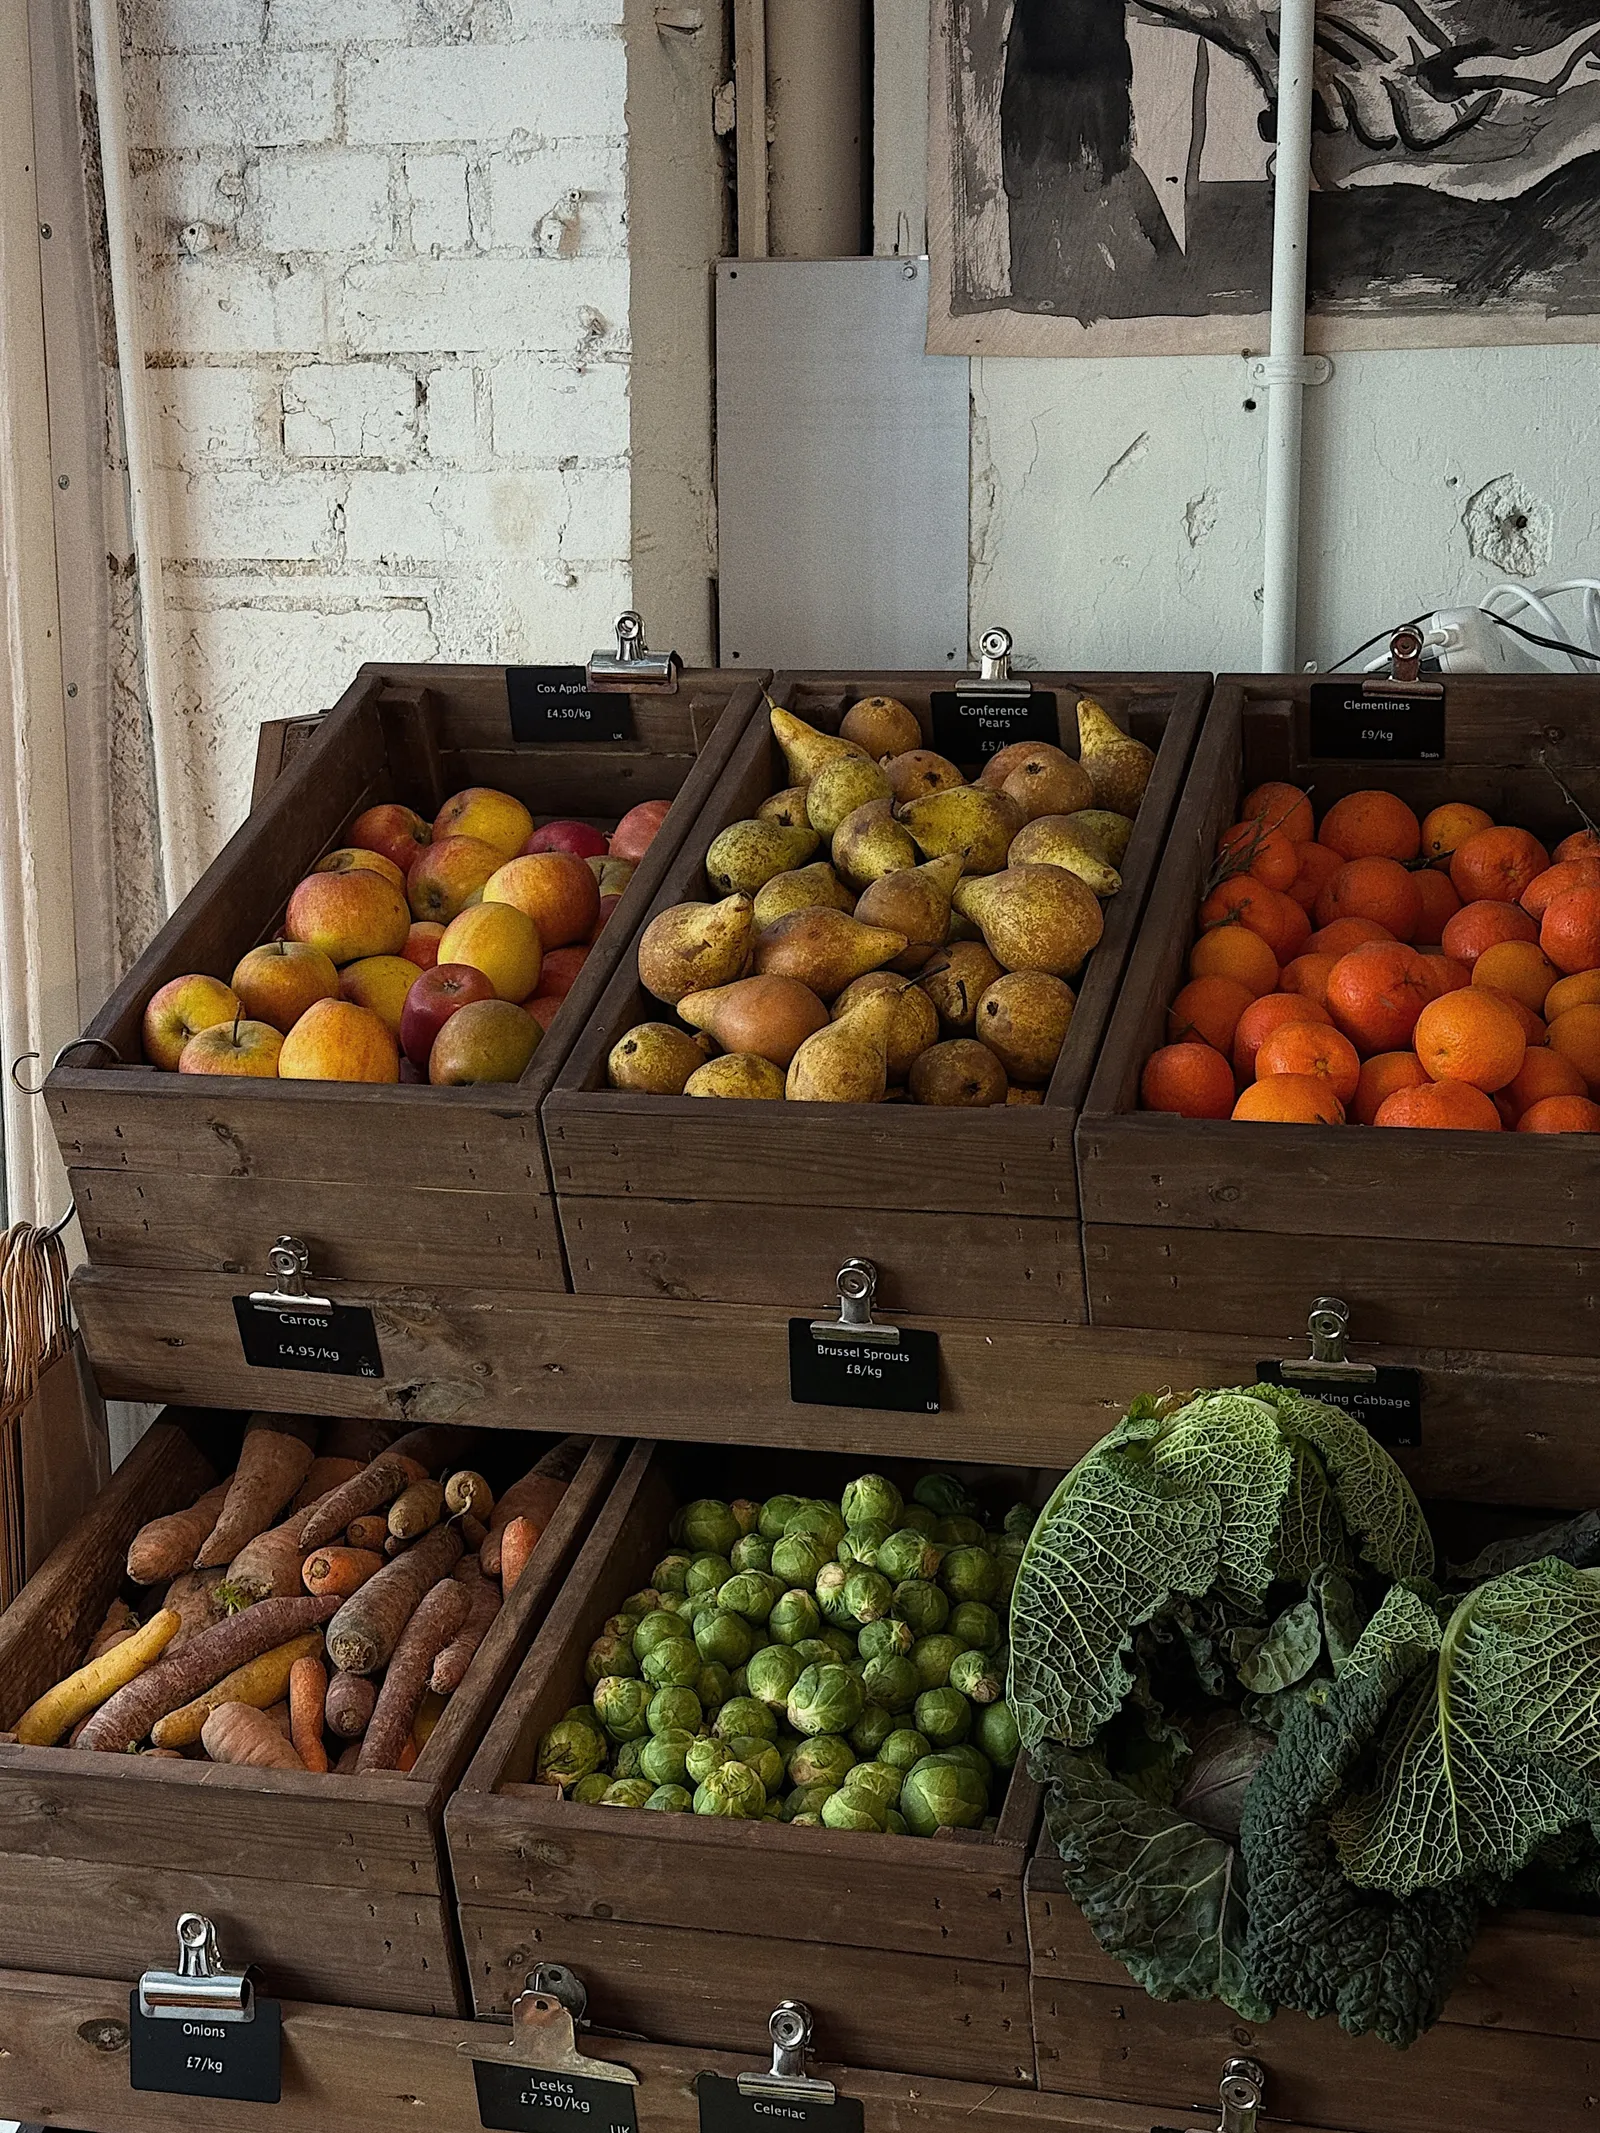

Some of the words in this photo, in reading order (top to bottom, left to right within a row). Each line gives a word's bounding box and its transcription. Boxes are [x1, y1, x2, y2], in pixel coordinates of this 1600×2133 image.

[537, 684, 556, 693] Cox
[559, 683, 589, 695] Apple
[959, 705, 1028, 716] Conference
[1343, 700, 1411, 711] Clementines
[547, 709, 591, 720] £4.50/kg
[979, 718, 1011, 728] Pears
[1361, 730, 1393, 741] £9/kg
[981, 741, 1010, 752] £5/k
[279, 1313, 329, 1328] Carrots
[279, 1344, 340, 1361] £4.95/kg
[817, 1344, 860, 1358] Brussel
[863, 1348, 910, 1362] Sprouts
[361, 1367, 376, 1377] UK
[846, 1363, 882, 1378] £8/kg
[926, 1401, 939, 1410] UK
[1320, 1393, 1349, 1405] King
[1353, 1394, 1411, 1408] Cabbage
[182, 2022, 226, 2038] Onions
[186, 2056, 223, 2073] £7/kg
[531, 2078, 574, 2094] Leeks
[520, 2092, 591, 2113] £7.50/kg
[753, 2102, 806, 2120] Celeriac
